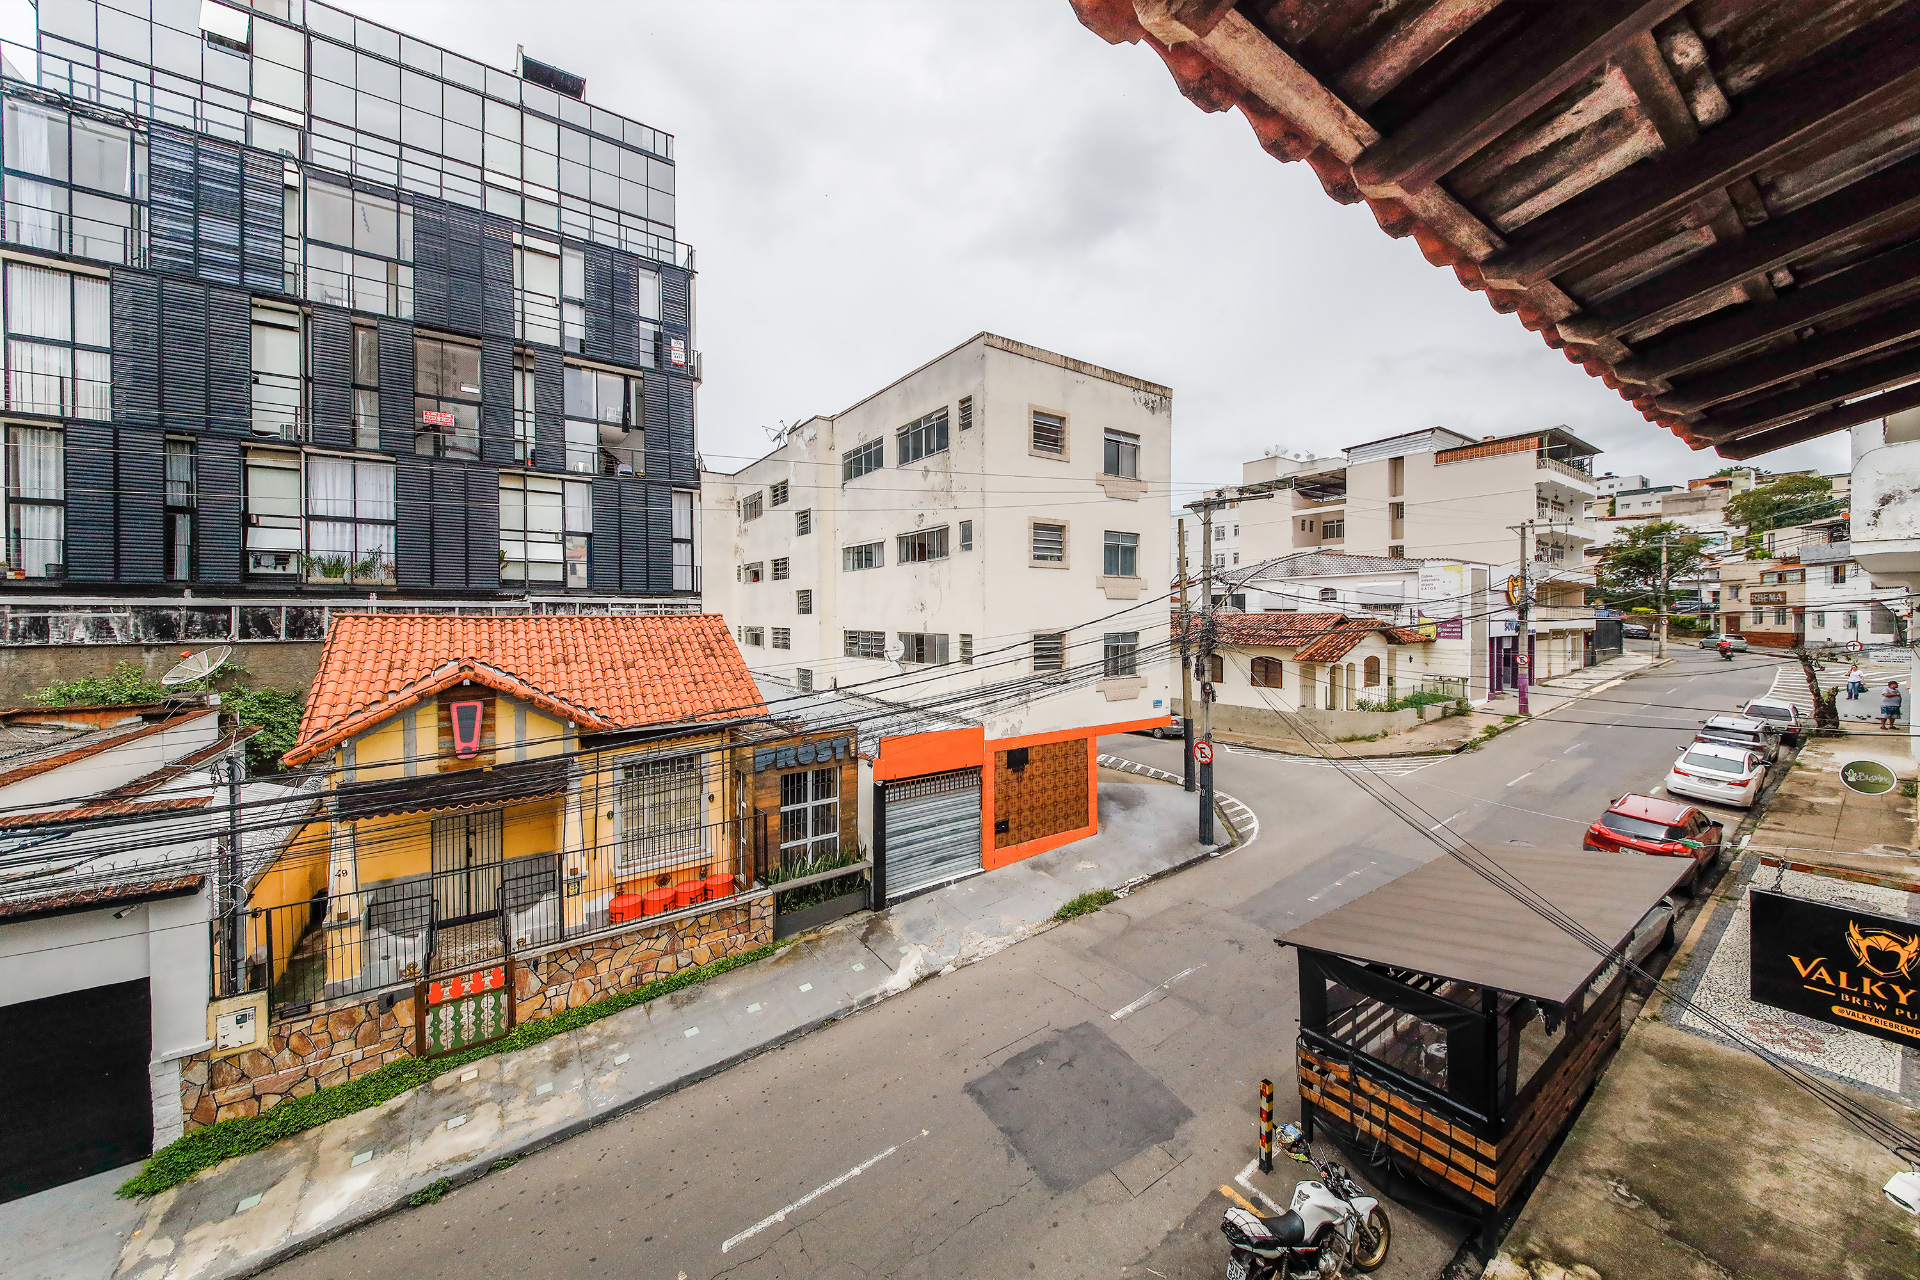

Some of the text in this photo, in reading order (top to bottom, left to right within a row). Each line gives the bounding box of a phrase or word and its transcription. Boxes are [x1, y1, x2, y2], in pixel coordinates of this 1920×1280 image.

[1752, 593, 1783, 603] RHEMA
[335, 869, 348, 877] 49
[1787, 954, 1918, 1005] VALKY
[1841, 993, 1887, 1011] BREW
